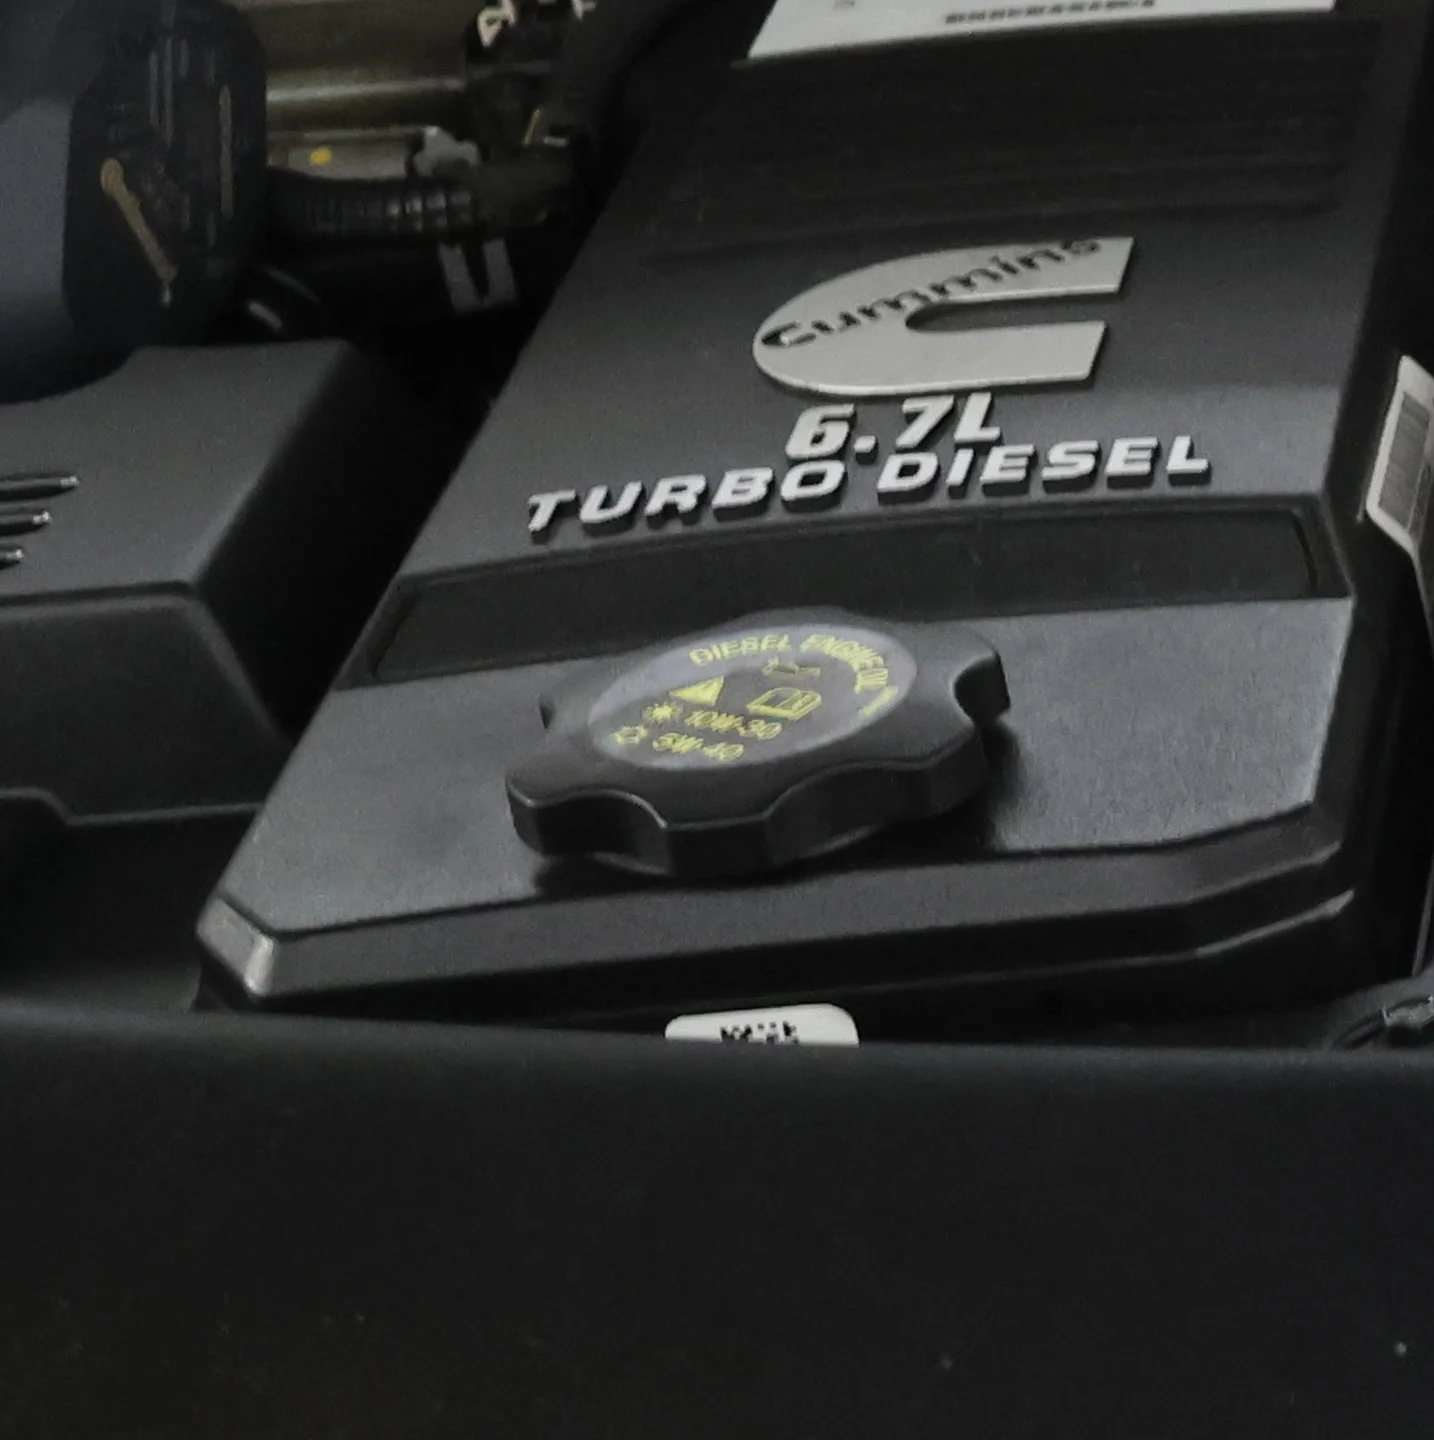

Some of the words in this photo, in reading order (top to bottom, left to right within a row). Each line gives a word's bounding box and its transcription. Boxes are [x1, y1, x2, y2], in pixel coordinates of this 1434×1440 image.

[785, 391, 1001, 460] 6.7L
[527, 459, 850, 534] TURBO
[876, 434, 1210, 495] DIESEL
[688, 633, 792, 666] DIESEL
[800, 633, 885, 671] ENGINE
[684, 709, 784, 741] 10W-30
[651, 731, 745, 762] 5W-40
